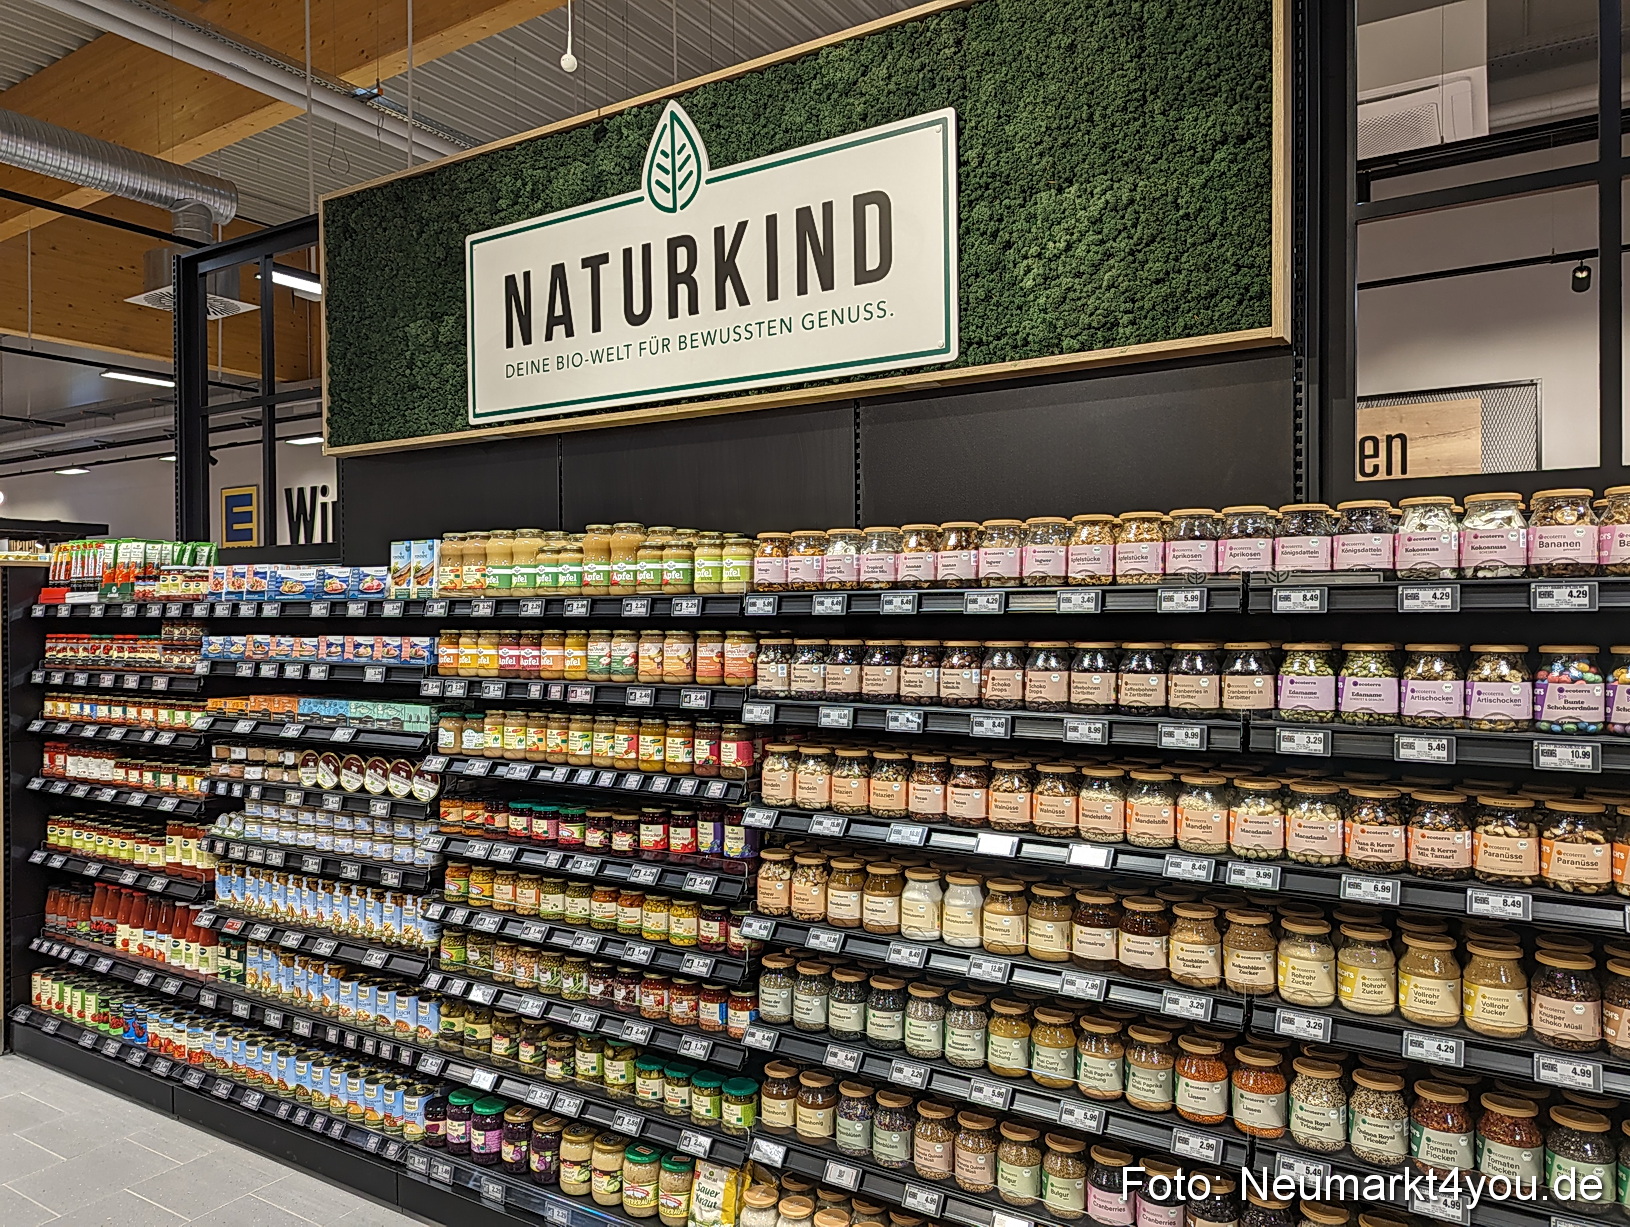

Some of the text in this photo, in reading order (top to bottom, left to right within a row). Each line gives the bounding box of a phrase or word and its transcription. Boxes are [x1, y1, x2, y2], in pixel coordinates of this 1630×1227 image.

[505, 190, 894, 349] NATURKIND
[505, 300, 894, 379] DEINE BIO-WELT FÜR BEWUSSTEN GENUSS.
[1539, 540, 1581, 548] Bananen
[1341, 546, 1382, 554] Königsdatteln
[1184, 594, 1198, 602] 5.99
[1302, 594, 1318, 602] 8.49
[1431, 591, 1450, 600] 4.29
[1568, 590, 1588, 599] 4.29
[1410, 694, 1453, 702] Artischocken
[1184, 731, 1199, 739] 9.99
[1306, 736, 1322, 745] 3.29
[1427, 743, 1446, 751] 5.49
[1570, 750, 1590, 759] 10.99
[1186, 822, 1212, 830] Mandeln
[1484, 851, 1523, 860] Paranüsse
[1191, 862, 1206, 871] 8.49
[1557, 857, 1598, 867] Paranüsse
[1256, 870, 1272, 879] 9.99
[1374, 885, 1391, 893] 6.99
[1503, 899, 1521, 908] 8.49
[1291, 972, 1316, 981] Rohrohr
[1085, 981, 1098, 990] 7.99
[1291, 978, 1312, 987] Zucker
[1361, 981, 1386, 989] Rohrohr
[1362, 987, 1384, 995] Zucker
[1413, 990, 1440, 1000] Vollrohr
[1189, 1000, 1204, 1009] 3.29
[1413, 997, 1437, 1006] Zucker
[1482, 1001, 1509, 1011] Vollrohr
[1482, 1008, 1506, 1016] Zucker
[1539, 1010, 1565, 1021] Knusper
[1306, 1020, 1323, 1030] 3.29
[1539, 1017, 1582, 1030] Schoko Müsli
[1436, 1044, 1455, 1054] 4.29
[1571, 1067, 1592, 1078] 4.99
[991, 1089, 1004, 1099] 5.99
[1083, 1112, 1097, 1122] 5.99
[1198, 1139, 1215, 1151] 2.99
[1426, 1142, 1458, 1156] Tomaten
[1426, 1151, 1456, 1162] Flocken
[1487, 1156, 1520, 1169] Tomaten
[1305, 1166, 1322, 1176] 5.49
[696, 1184, 720, 1197] Sauer
[1050, 1189, 1069, 1199] Bulgur
[696, 1194, 717, 1208] Kraut
[1442, 1199, 1461, 1210] 4.99
